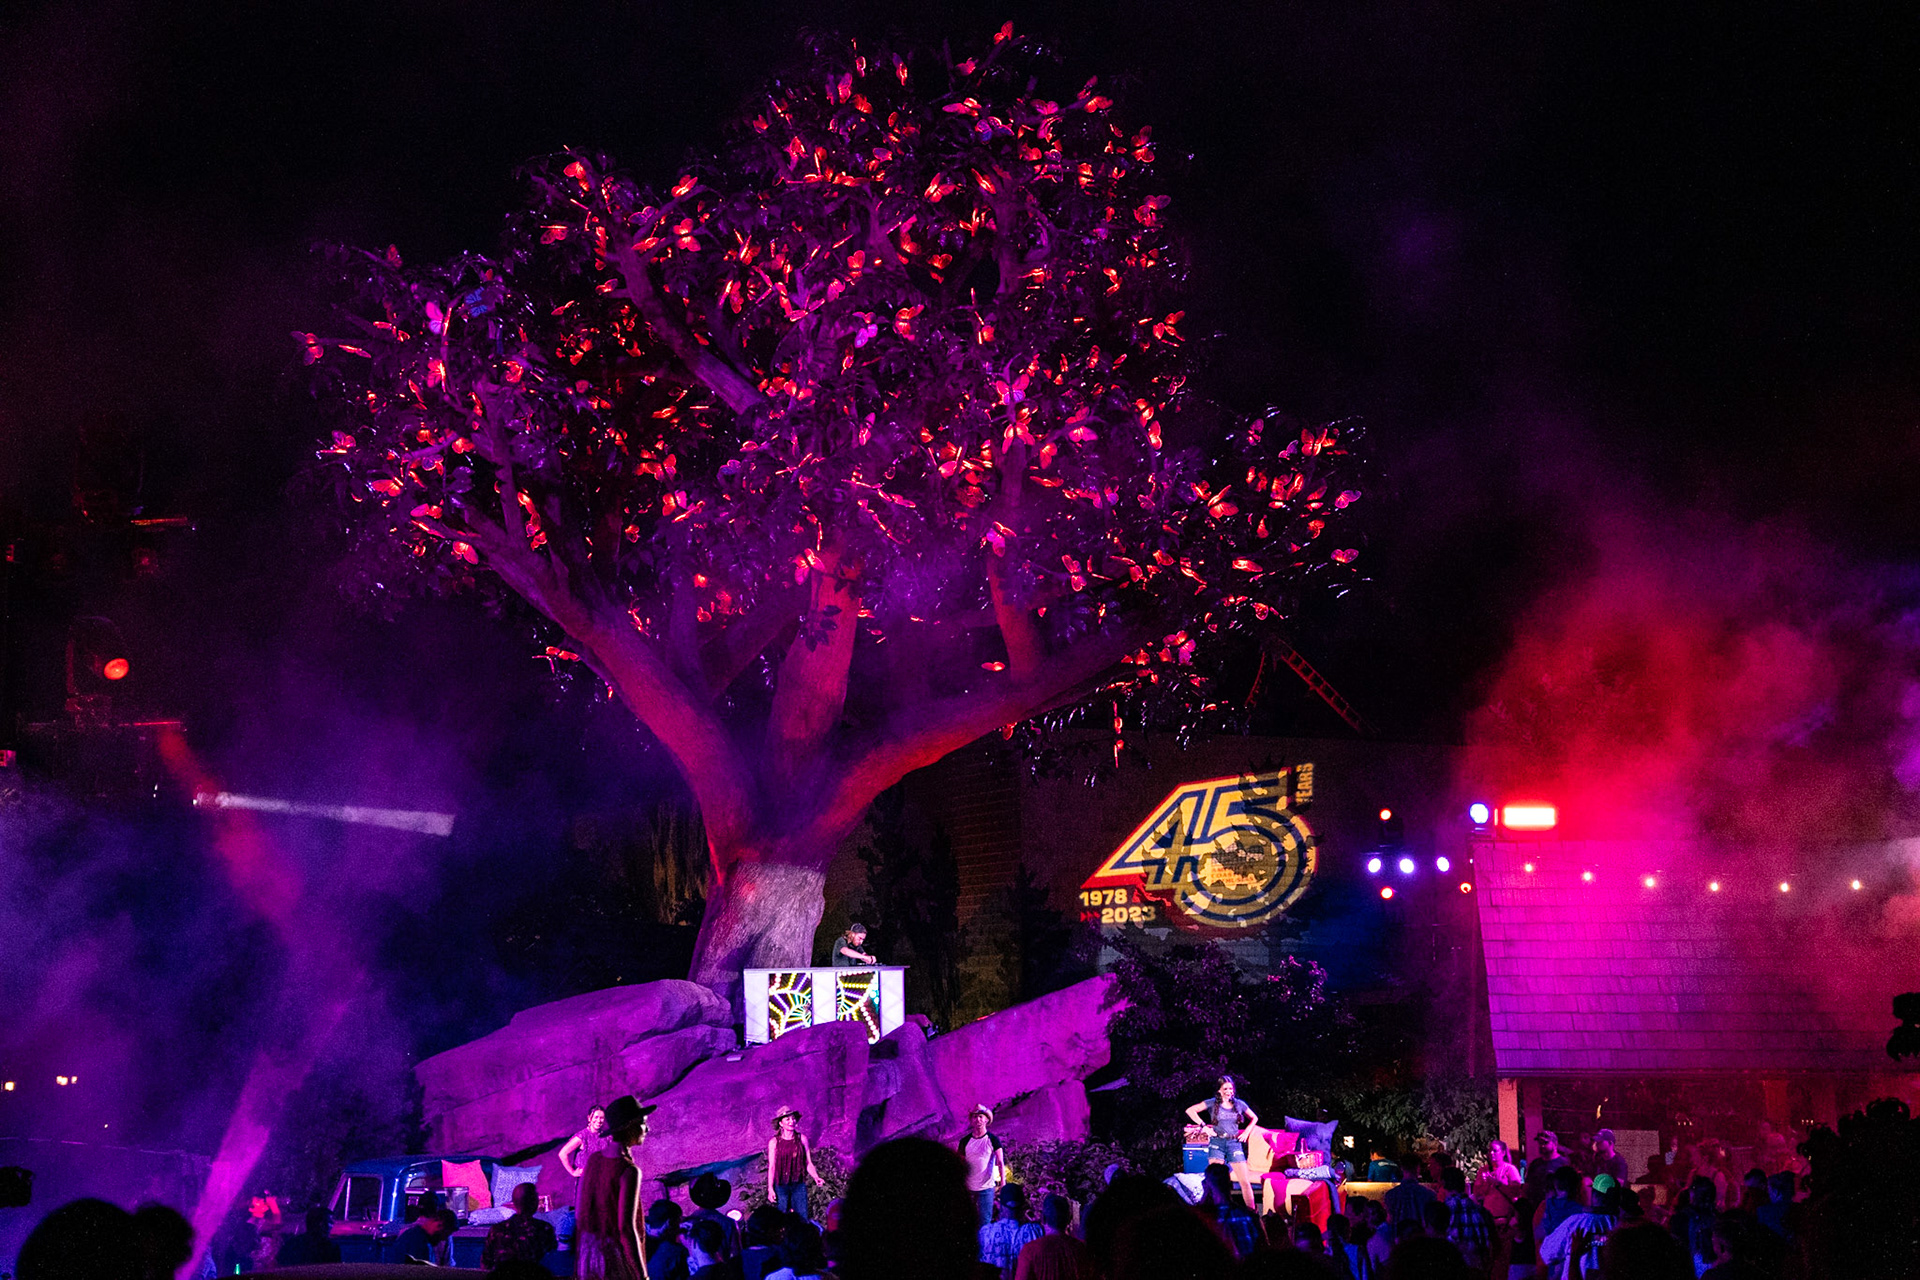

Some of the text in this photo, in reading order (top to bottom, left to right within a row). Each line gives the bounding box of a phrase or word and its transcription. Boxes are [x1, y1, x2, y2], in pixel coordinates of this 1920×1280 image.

[1094, 769, 1318, 928] 45
[1079, 888, 1128, 907] 1978
[1101, 905, 1156, 924] 2023
